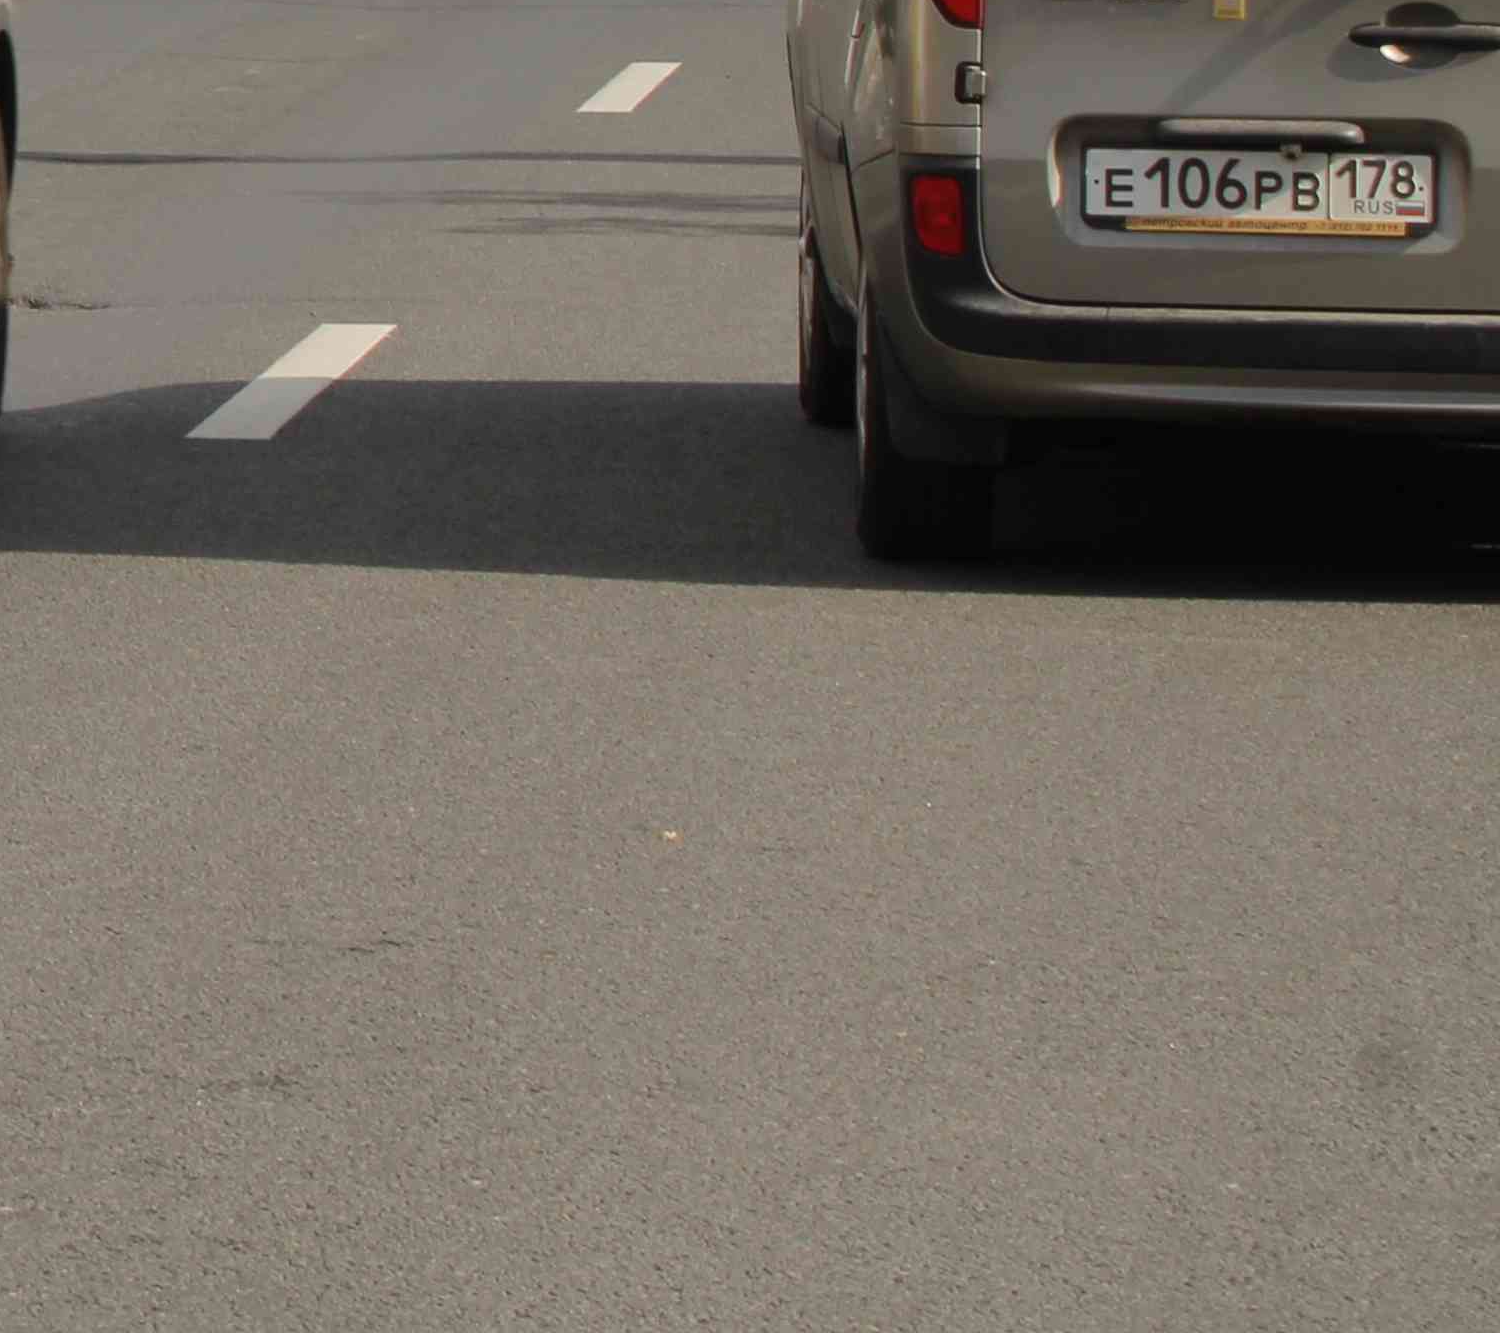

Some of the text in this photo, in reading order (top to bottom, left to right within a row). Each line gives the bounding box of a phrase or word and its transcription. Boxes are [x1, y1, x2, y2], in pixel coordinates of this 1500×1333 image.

[1104, 157, 1416, 212] Е106РВ 178
[1354, 200, 1394, 214] RUS
